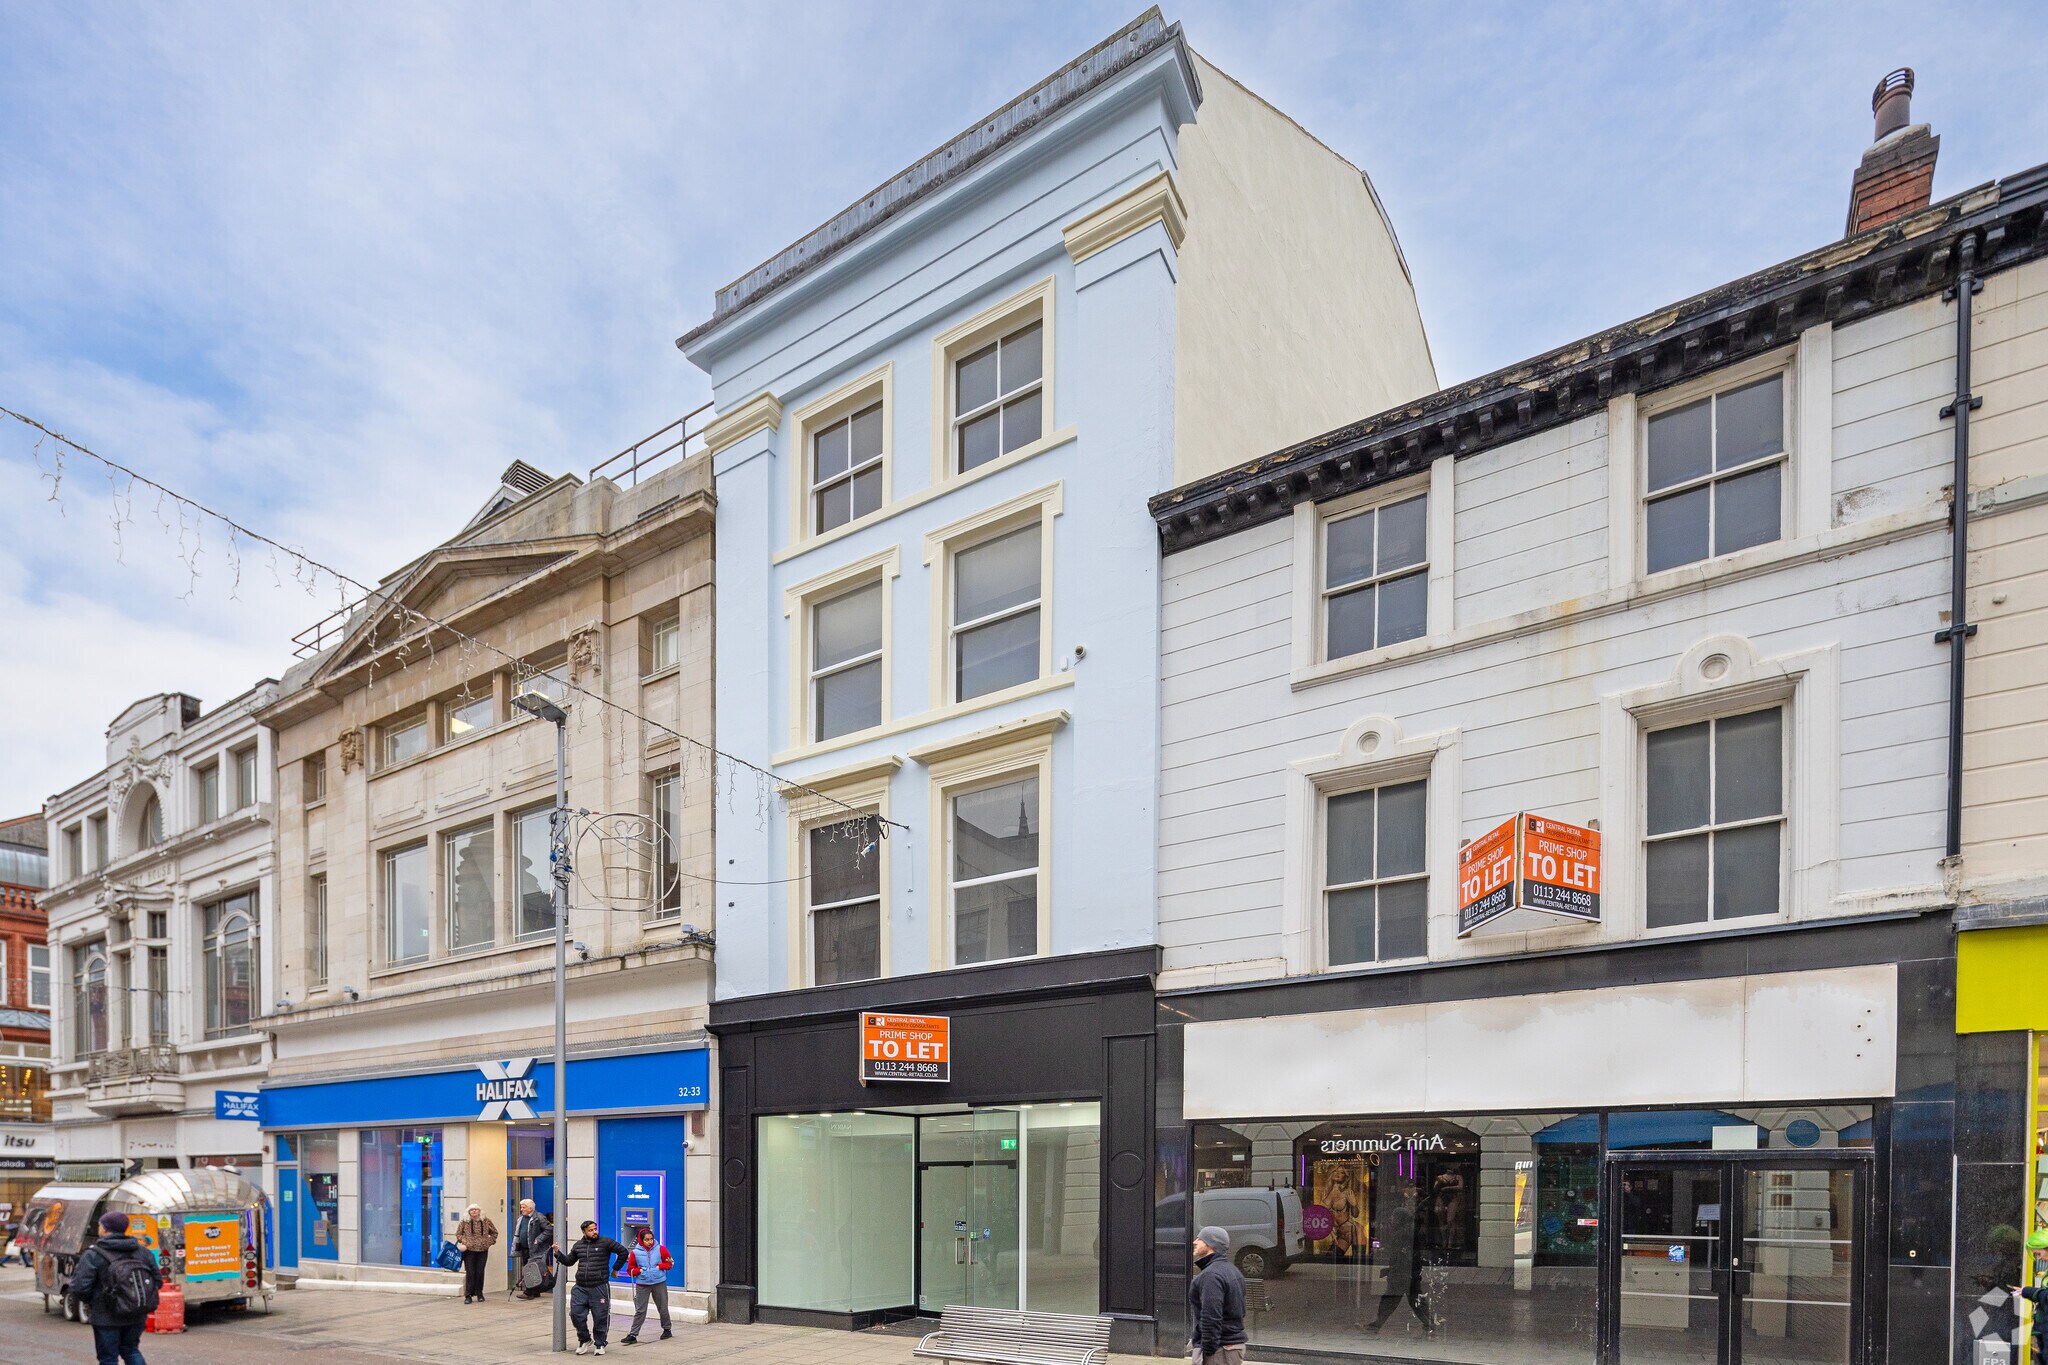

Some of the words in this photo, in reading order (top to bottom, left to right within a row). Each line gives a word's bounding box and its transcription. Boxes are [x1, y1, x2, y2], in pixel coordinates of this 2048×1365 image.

[1546, 822, 1566, 832] CENTRAL
[1567, 828, 1581, 836] RETAIL
[1473, 839, 1488, 851] CENTRAL
[1487, 830, 1500, 842] RETAIL
[1546, 830, 1566, 838] PROPERTY
[1567, 834, 1593, 846] CONSULTANTS
[1539, 840, 1564, 855] PRIME
[1567, 847, 1587, 860] SHOP
[1468, 858, 1486, 876] PRIME
[1488, 846, 1504, 865] SHOP
[1529, 852, 1556, 880] TO
[1563, 860, 1596, 888] LET
[1462, 875, 1480, 903] TO
[1485, 855, 1511, 892] LET
[1465, 904, 1478, 919] 0113
[1479, 897, 1490, 912] 244
[1491, 888, 1506, 905] 8668
[1533, 884, 1553, 898] 0113
[1556, 889, 1570, 902] 244
[1572, 892, 1591, 906] 8668
[1533, 898, 1591, 914] WWW.CENTRAL-RETAIL.CO.UK
[879, 1031, 907, 1039] PRIME
[910, 1032, 933, 1040] SHOP
[869, 1040, 899, 1058] TO
[906, 1042, 943, 1059] LET
[875, 1062, 896, 1070] 0113
[899, 1062, 914, 1071] 244
[917, 1063, 938, 1072] 8668
[477, 1079, 535, 1101] HALIFAX
[679, 1086, 700, 1096] 32-33
[223, 1101, 259, 1111] HALIFAX
[4, 1135, 35, 1147] itsu
[328, 1185, 337, 1199] Hi
